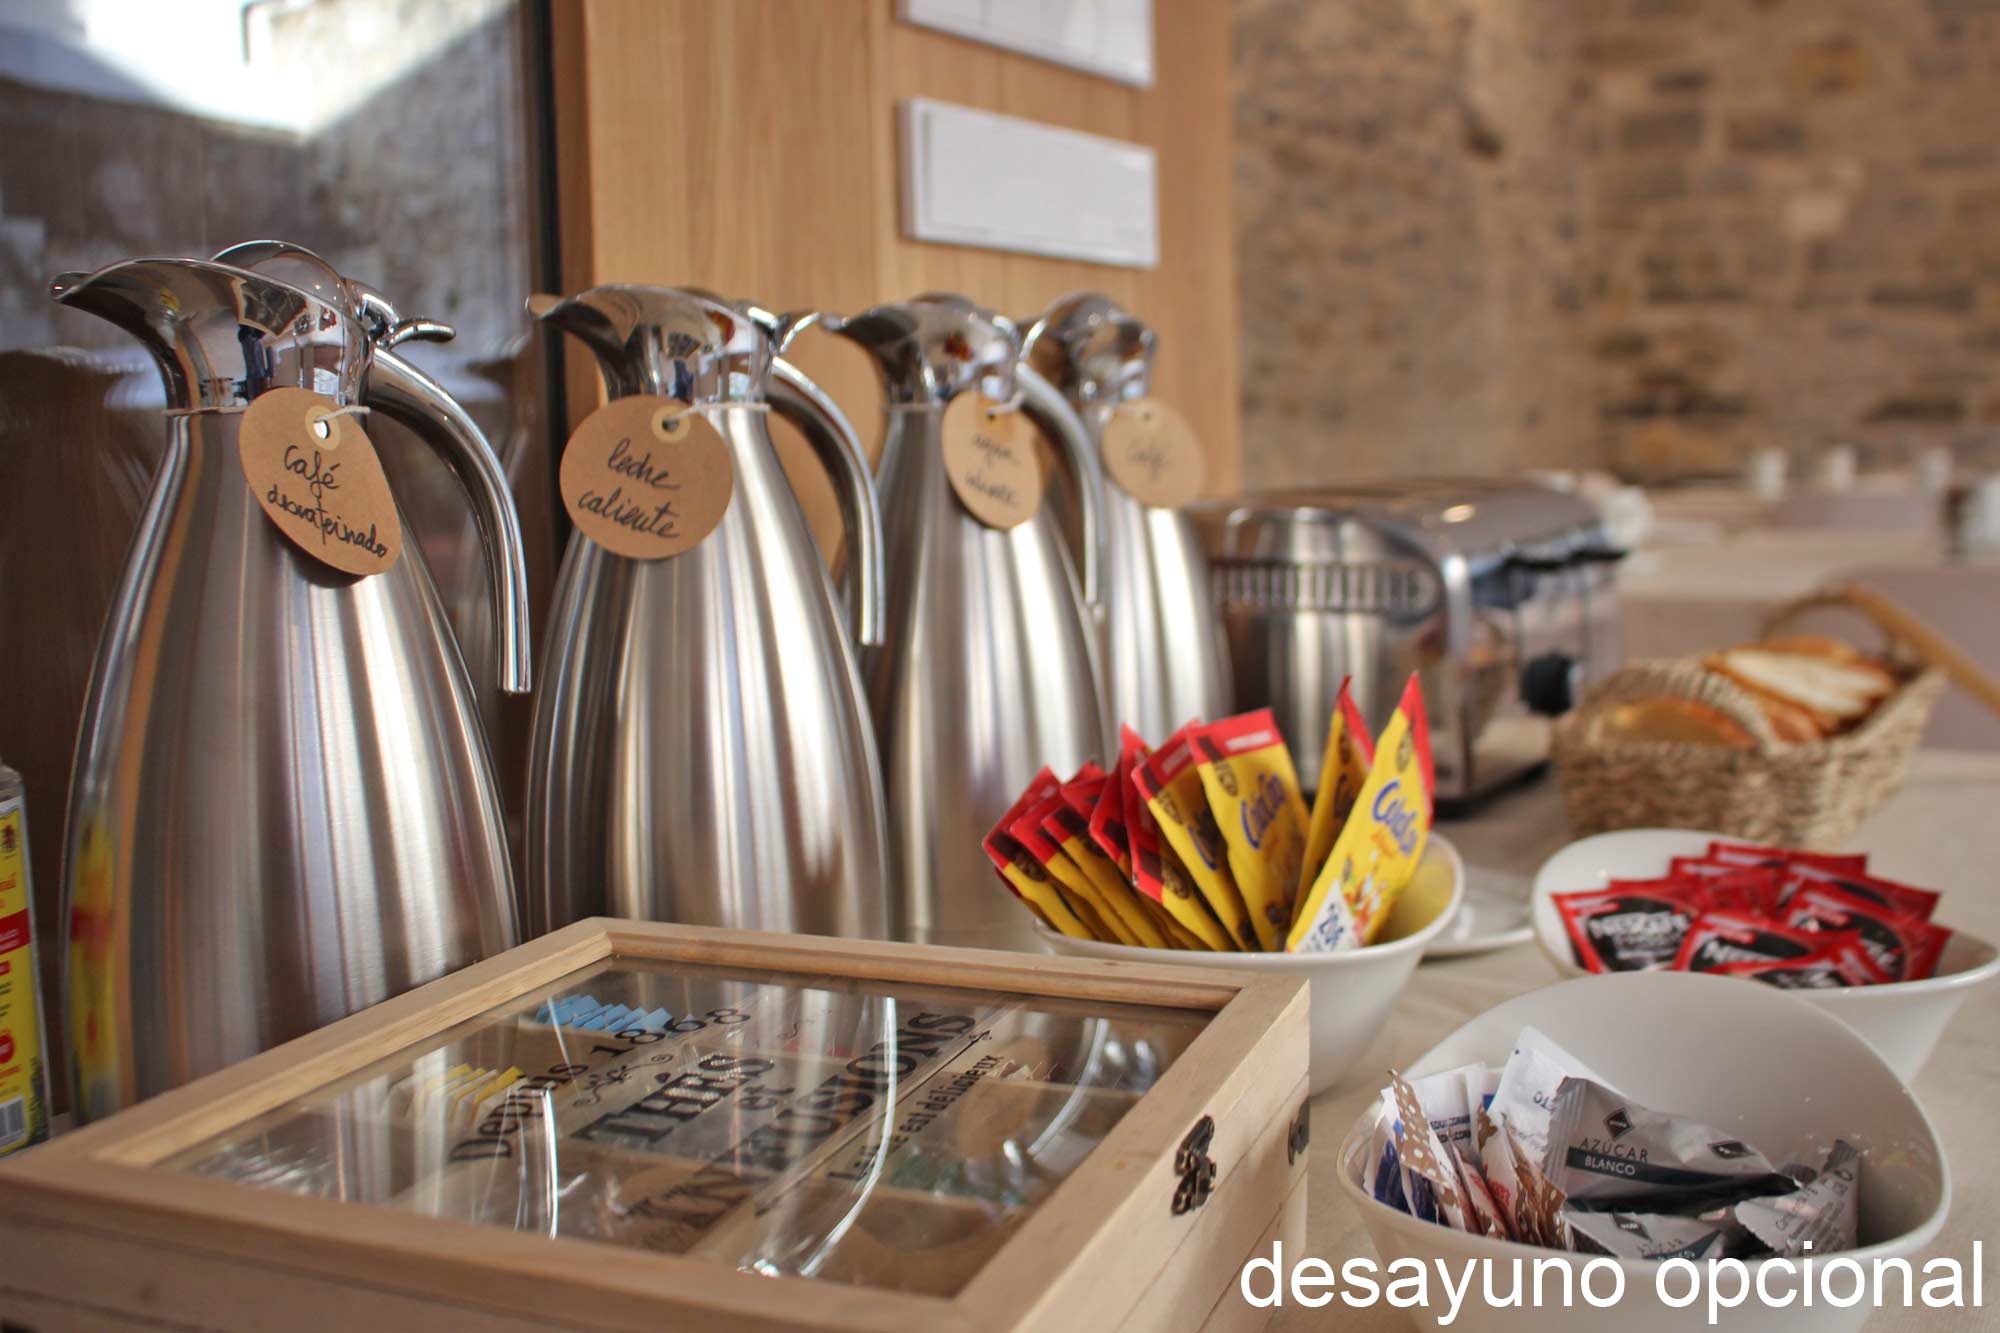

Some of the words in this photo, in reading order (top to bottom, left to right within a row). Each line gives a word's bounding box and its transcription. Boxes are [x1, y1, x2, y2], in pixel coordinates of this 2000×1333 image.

[284, 445, 341, 499] Café
[607, 437, 681, 490] leche
[577, 486, 681, 538] caliente
[449, 1063, 588, 1162] Depuis
[591, 1008, 751, 1058] 1868
[1584, 1156, 1636, 1176] BLANCO
